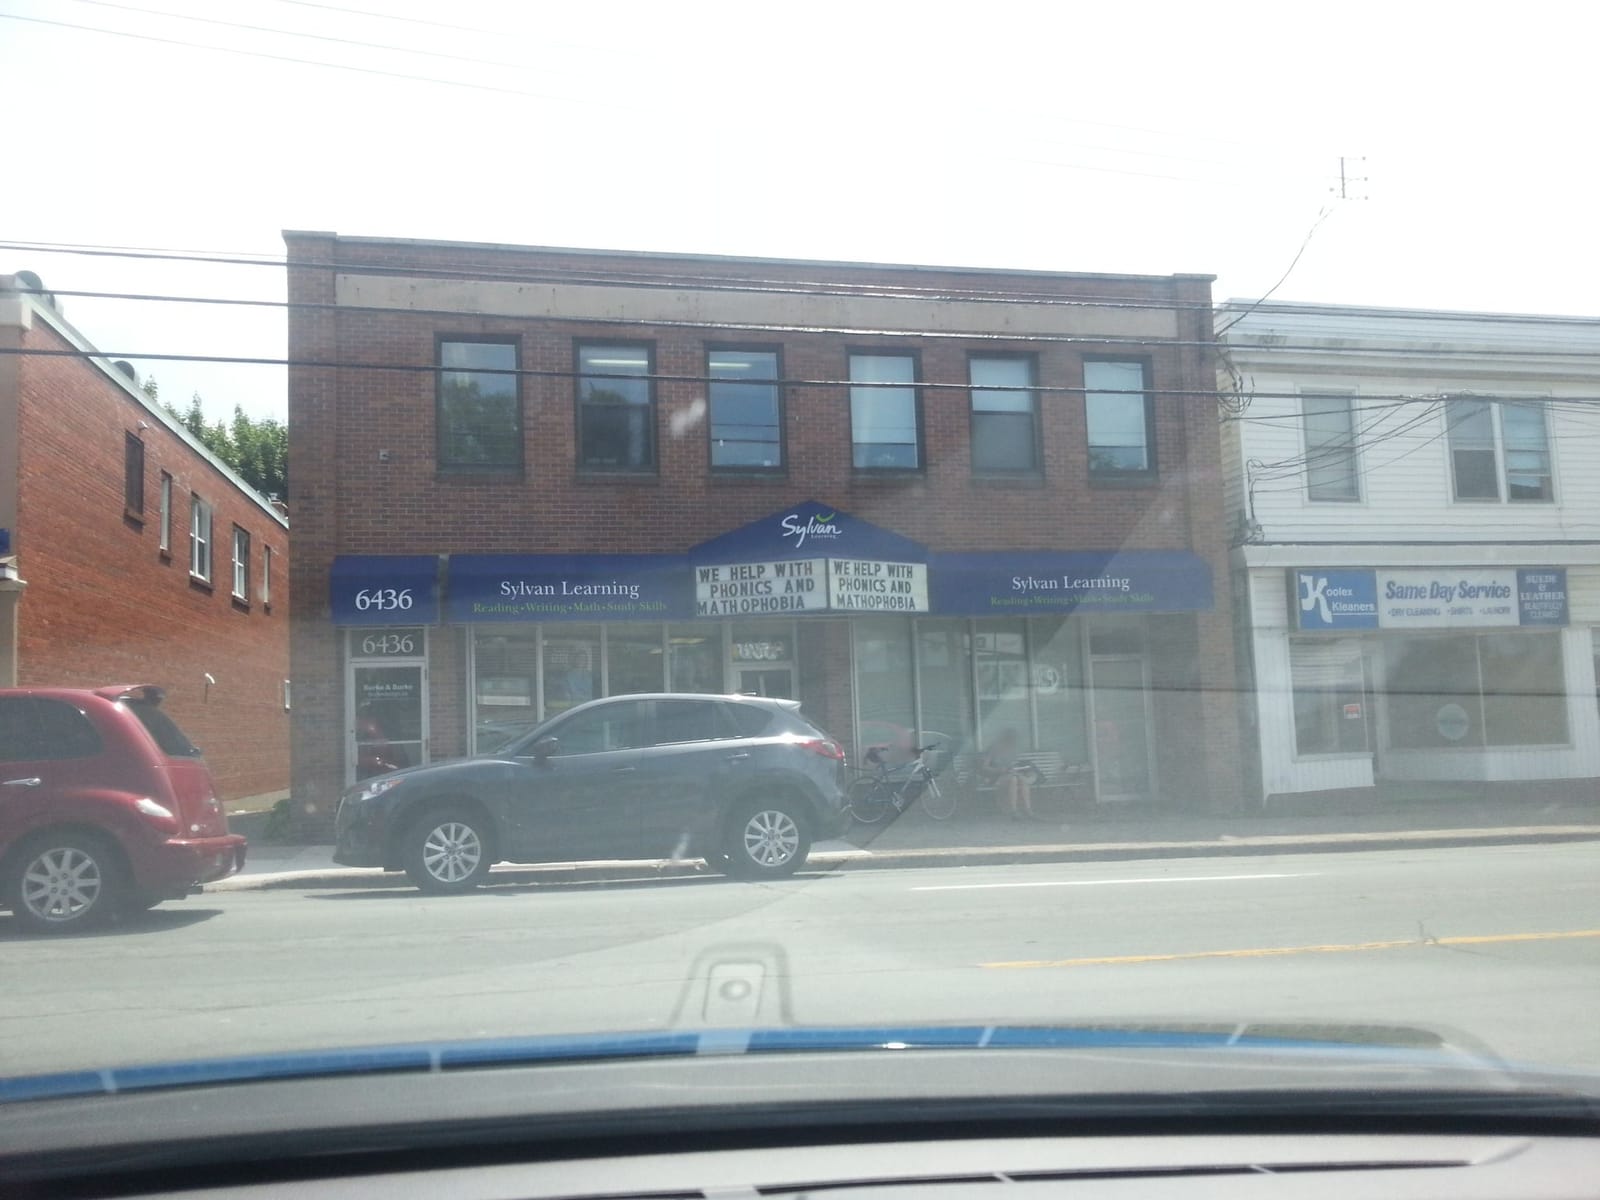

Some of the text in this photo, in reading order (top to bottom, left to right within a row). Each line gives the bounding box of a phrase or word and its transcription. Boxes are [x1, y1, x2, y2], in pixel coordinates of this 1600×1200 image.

[781, 514, 842, 548] Sylvan
[699, 561, 813, 583] WE HELP WITH
[834, 560, 914, 579] WE HELP WITH
[500, 580, 640, 600] Sylvan Learning
[710, 578, 815, 599] PHONICS AND
[839, 578, 912, 594] PHONICS AND
[1012, 575, 1130, 594] Sylvan Learning
[1385, 580, 1511, 603] Same Day Service
[355, 588, 413, 611] 6436
[473, 601, 667, 615] Reading Writing Math Study Skills
[836, 593, 917, 610] MATHOPHOBIA
[362, 635, 414, 653] 6436
